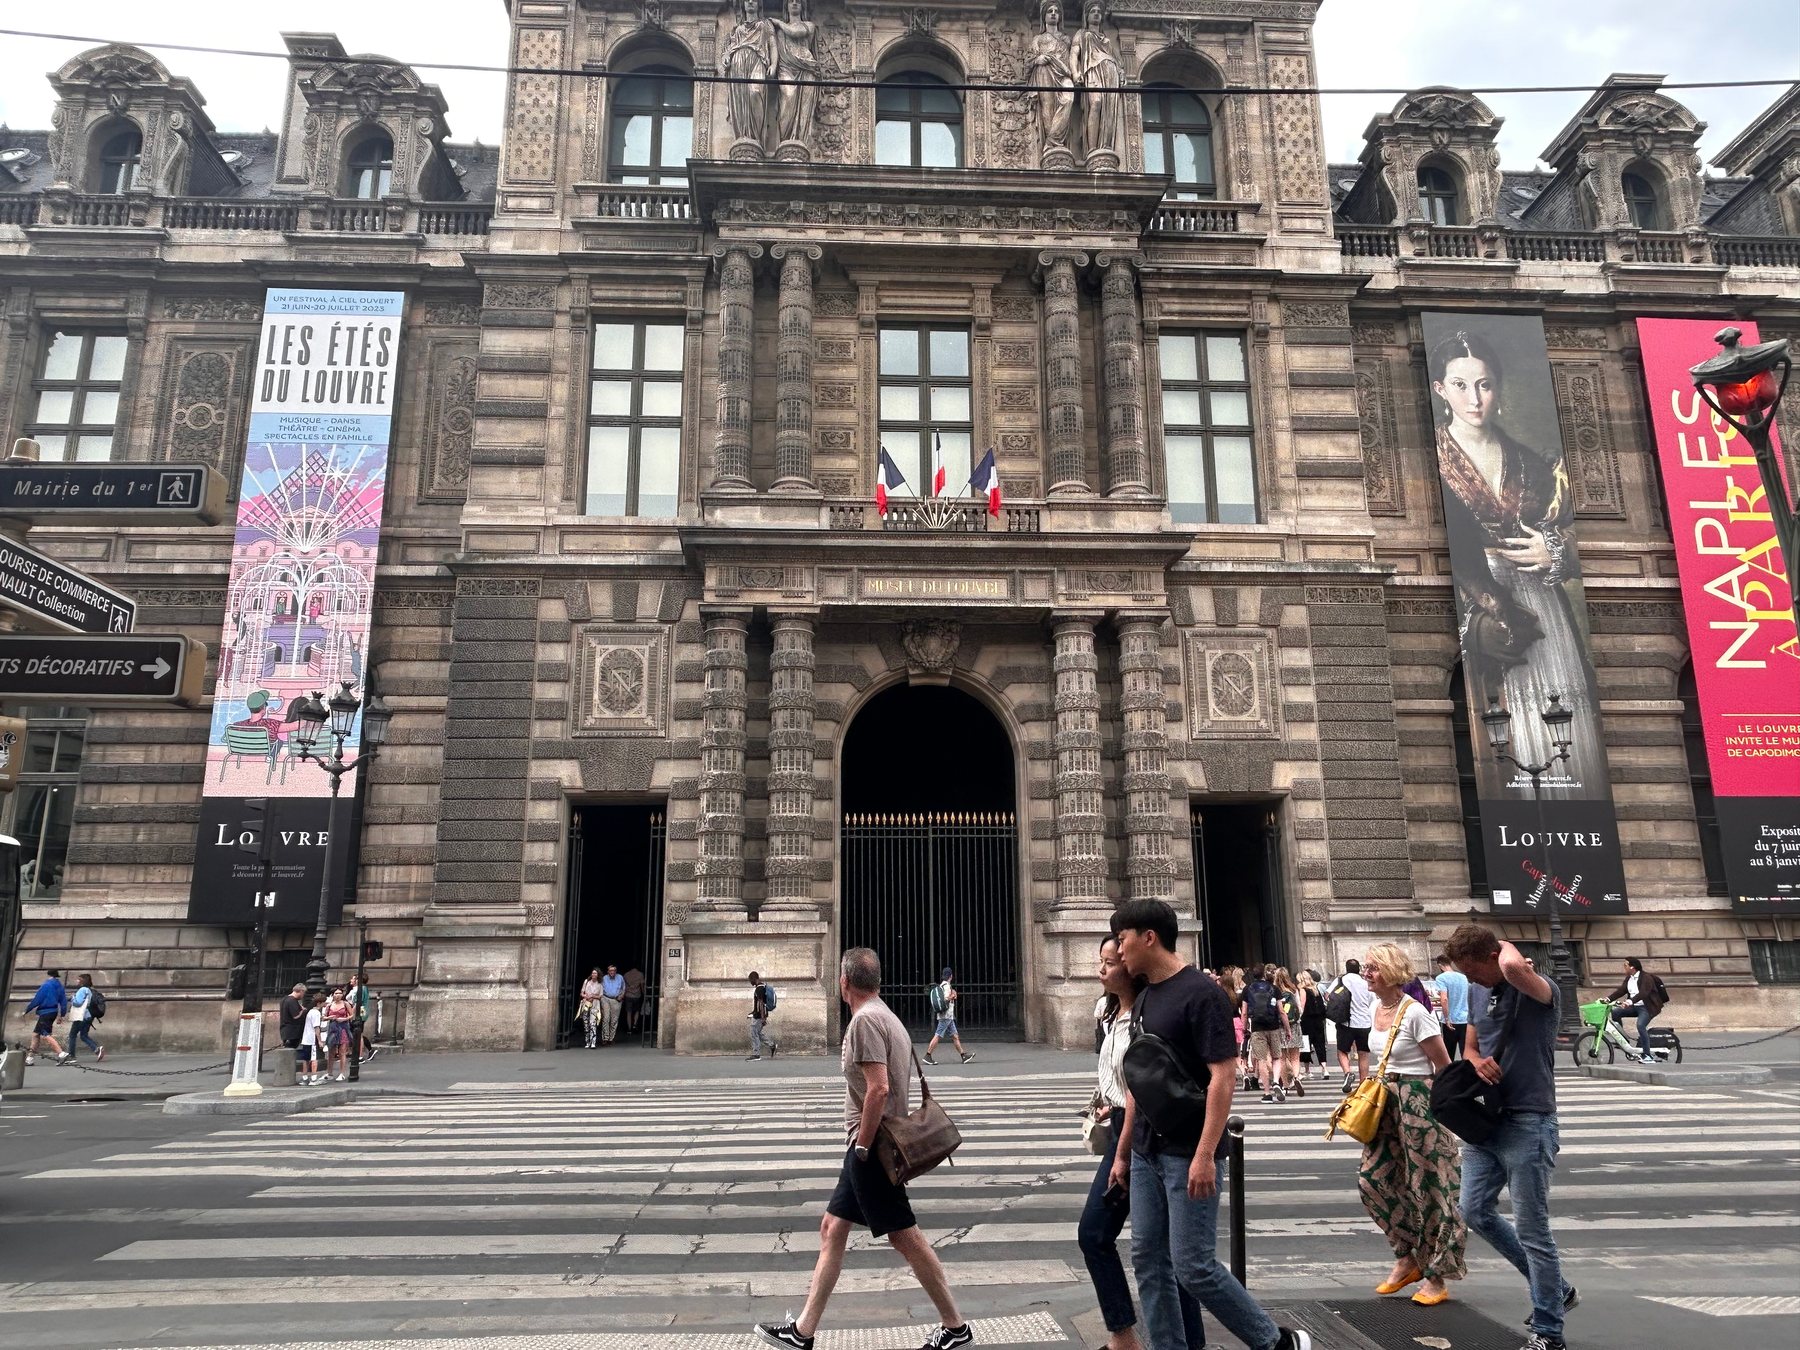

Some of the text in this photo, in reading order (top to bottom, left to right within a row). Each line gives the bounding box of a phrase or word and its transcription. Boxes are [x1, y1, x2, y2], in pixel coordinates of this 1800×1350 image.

[330, 295, 337, 303] À
[359, 297, 396, 305] OUVERT
[327, 304, 360, 312] JUILLET
[265, 321, 392, 367] LES ÉTÉS
[260, 368, 388, 405] DU LOUVRE
[280, 416, 321, 425] MUSIQUE
[330, 417, 361, 425] DANSE
[279, 424, 318, 432] THÉÂTRE
[326, 425, 362, 433] CINÉMA
[264, 432, 320, 440] SPECTACLES
[14, 480, 80, 496] Mairie
[92, 481, 115, 496] du
[1671, 389, 1767, 669] NAPLES
[0, 549, 111, 613] OURSE DE COMMERCE
[0, 571, 86, 623] NAULT Collection
[0, 654, 135, 675] TS DÉCORATIFS
[1738, 725, 1753, 733] LE
[1725, 736, 1763, 745] INVITE
[1766, 737, 1780, 745] LE
[1727, 748, 1743, 757] DE
[214, 823, 329, 846] LOVRE
[1754, 839, 1770, 851] du
[1771, 843, 1779, 854] 7
[1750, 858, 1764, 866] au
[1765, 854, 1773, 866] 8
